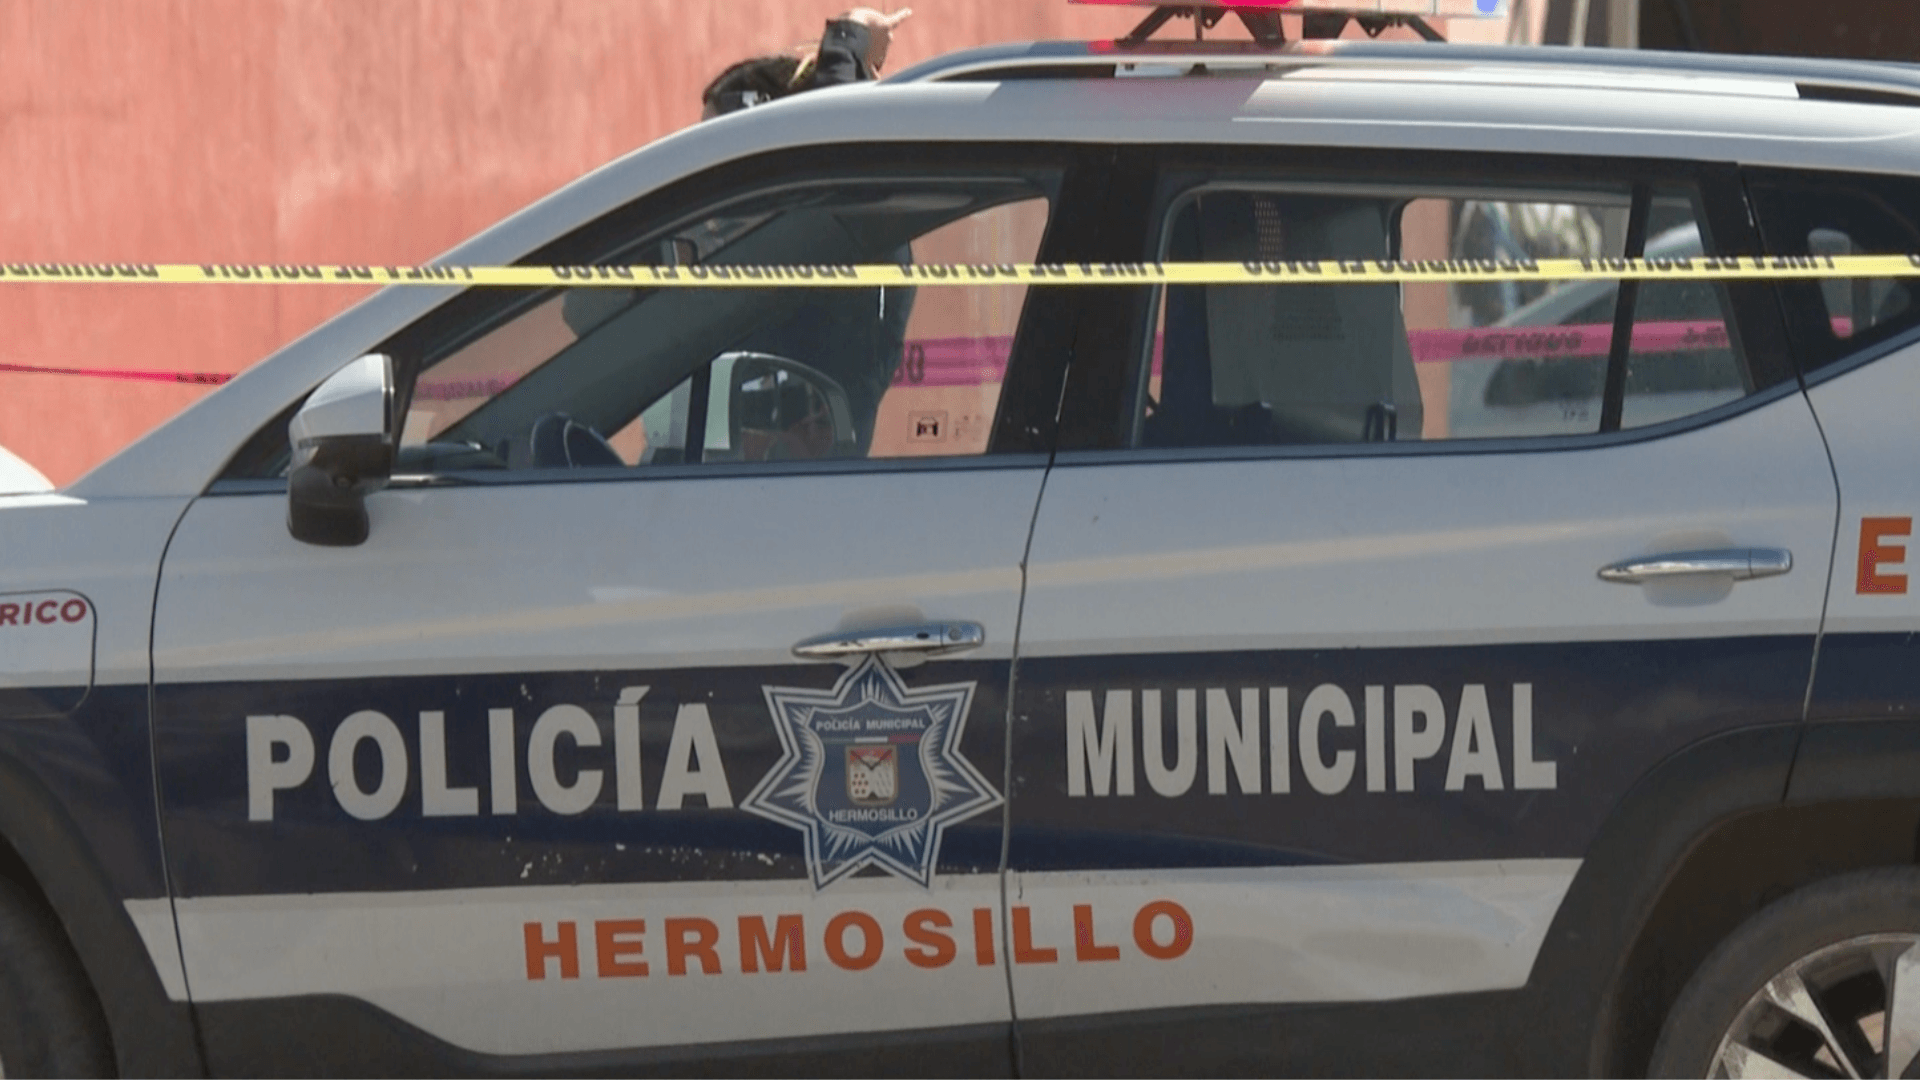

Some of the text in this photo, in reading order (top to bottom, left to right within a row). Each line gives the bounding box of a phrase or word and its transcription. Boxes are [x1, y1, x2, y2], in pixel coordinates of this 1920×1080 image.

[1856, 517, 1912, 595] E
[0, 598, 87, 626] RICO
[816, 717, 925, 731] POLICÍA MUNICIPAL
[246, 682, 1557, 822] POLICÍA MUNICIPAL
[829, 808, 918, 822] HERMOSILLO
[524, 901, 1194, 980] HERMOSILLO
